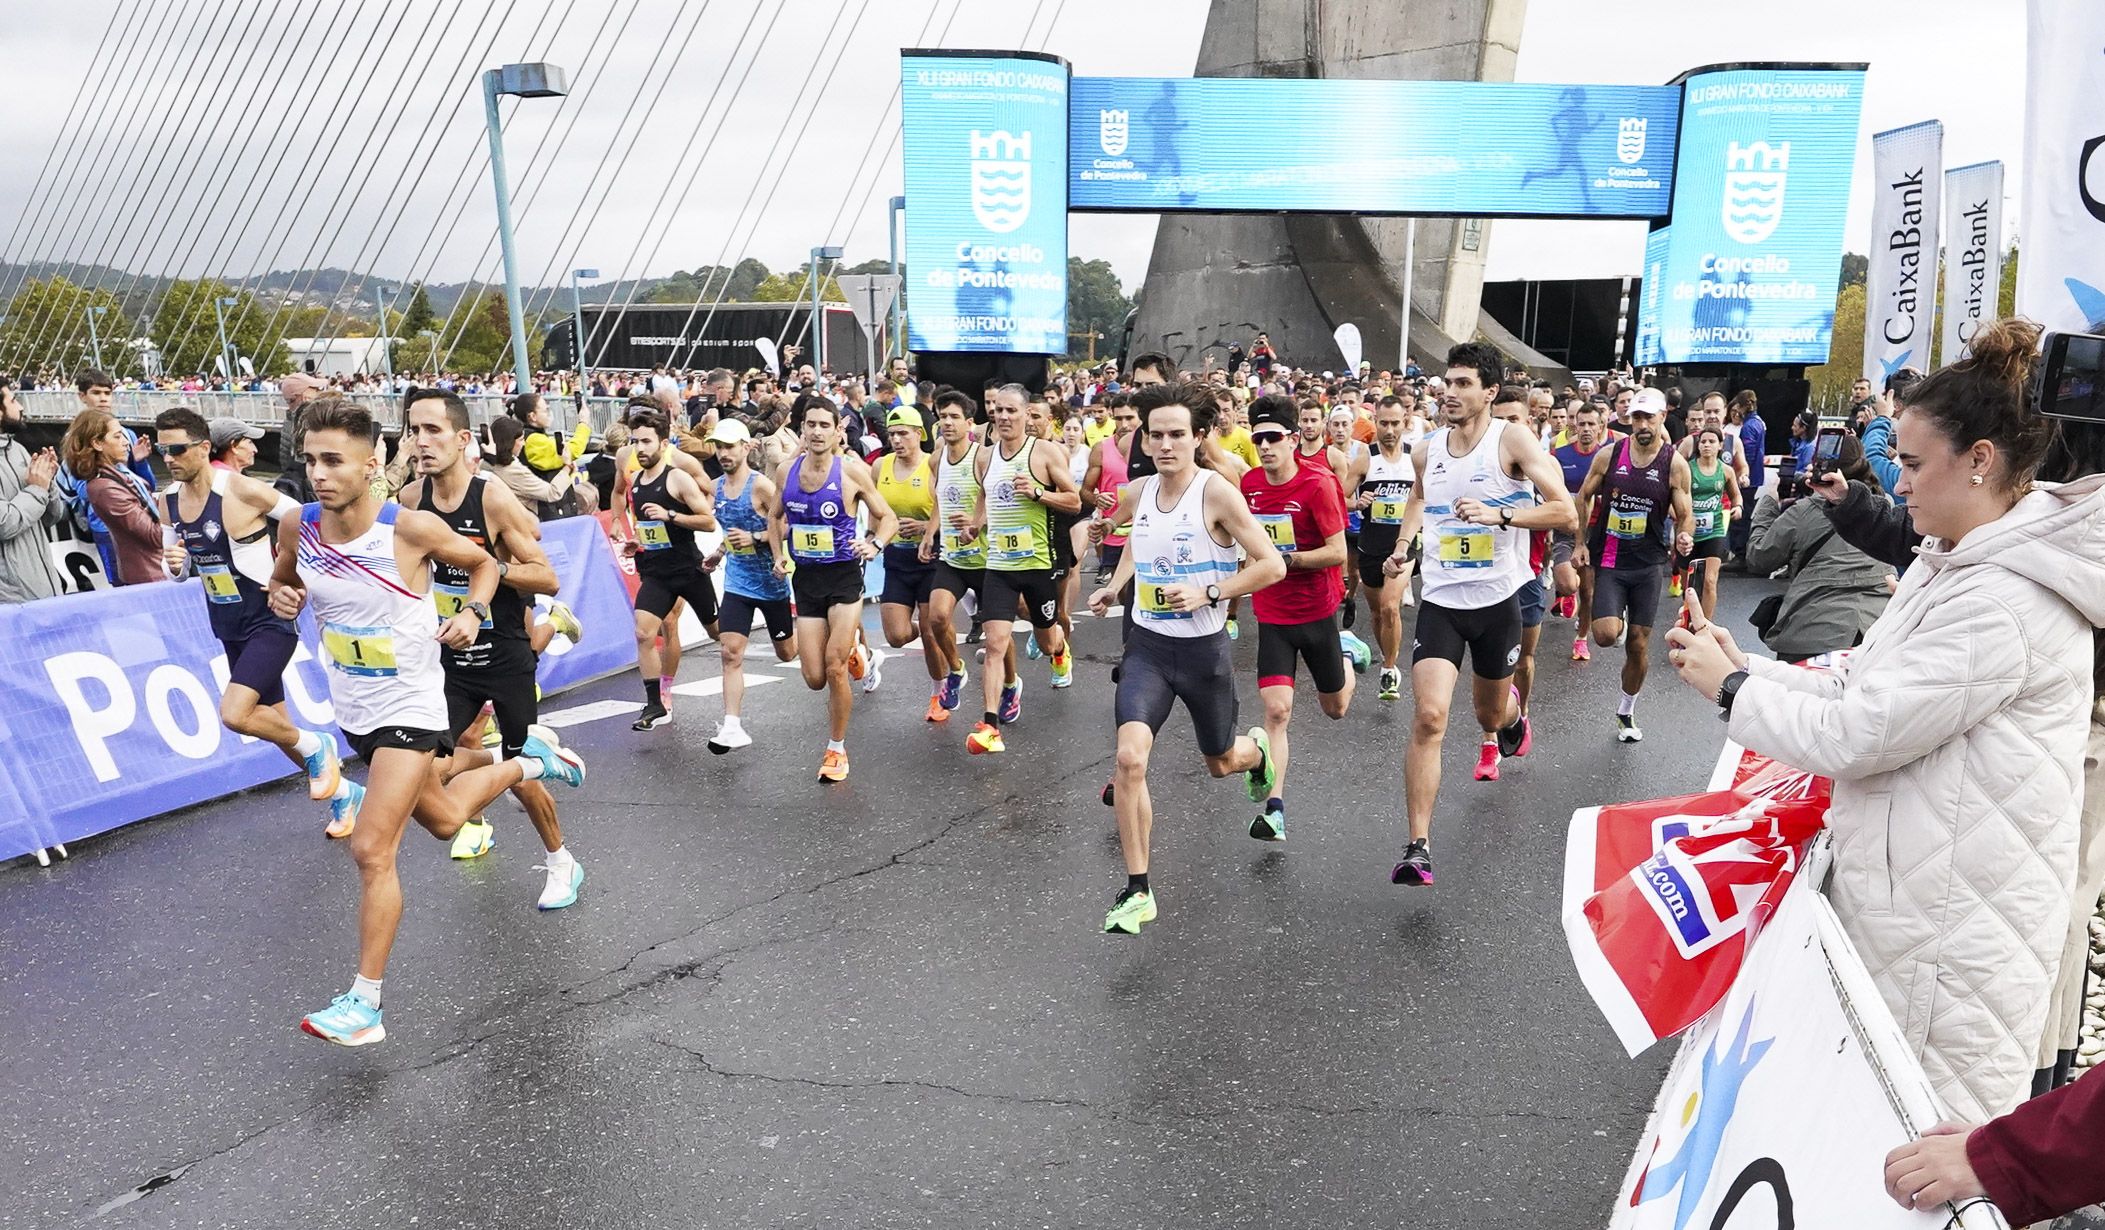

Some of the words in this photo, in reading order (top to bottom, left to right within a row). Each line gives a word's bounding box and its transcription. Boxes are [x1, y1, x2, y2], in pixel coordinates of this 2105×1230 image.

[974, 71, 1015, 88] FONDO
[1706, 83, 1737, 100] GRAN
[1739, 82, 1782, 98] FONDO
[1785, 82, 1849, 98] CAIXABANK
[1093, 159, 1134, 169] Concello
[1608, 166, 1648, 177] Concello
[956, 240, 1044, 263] Concello
[1884, 167, 1924, 345] CaixaBank
[1700, 253, 1789, 274] Concello
[1958, 199, 1989, 344] CaixaBank
[927, 268, 953, 288] de
[1673, 281, 1695, 300] de
[1699, 280, 1816, 300] Pontevedra
[977, 316, 1017, 332] FONDO
[1711, 327, 1752, 342] FONDO
[1373, 482, 1411, 497] delikia
[1620, 501, 1629, 509] As
[1621, 494, 1654, 505] Concello
[1384, 503, 1395, 515] 75
[1619, 519, 1632, 531] 51
[805, 533, 818, 546] 15
[1460, 537, 1470, 554] 5
[207, 575, 217, 592] 3
[1154, 586, 1166, 606] 6
[452, 597, 462, 614] 2
[351, 639, 363, 660] 1
